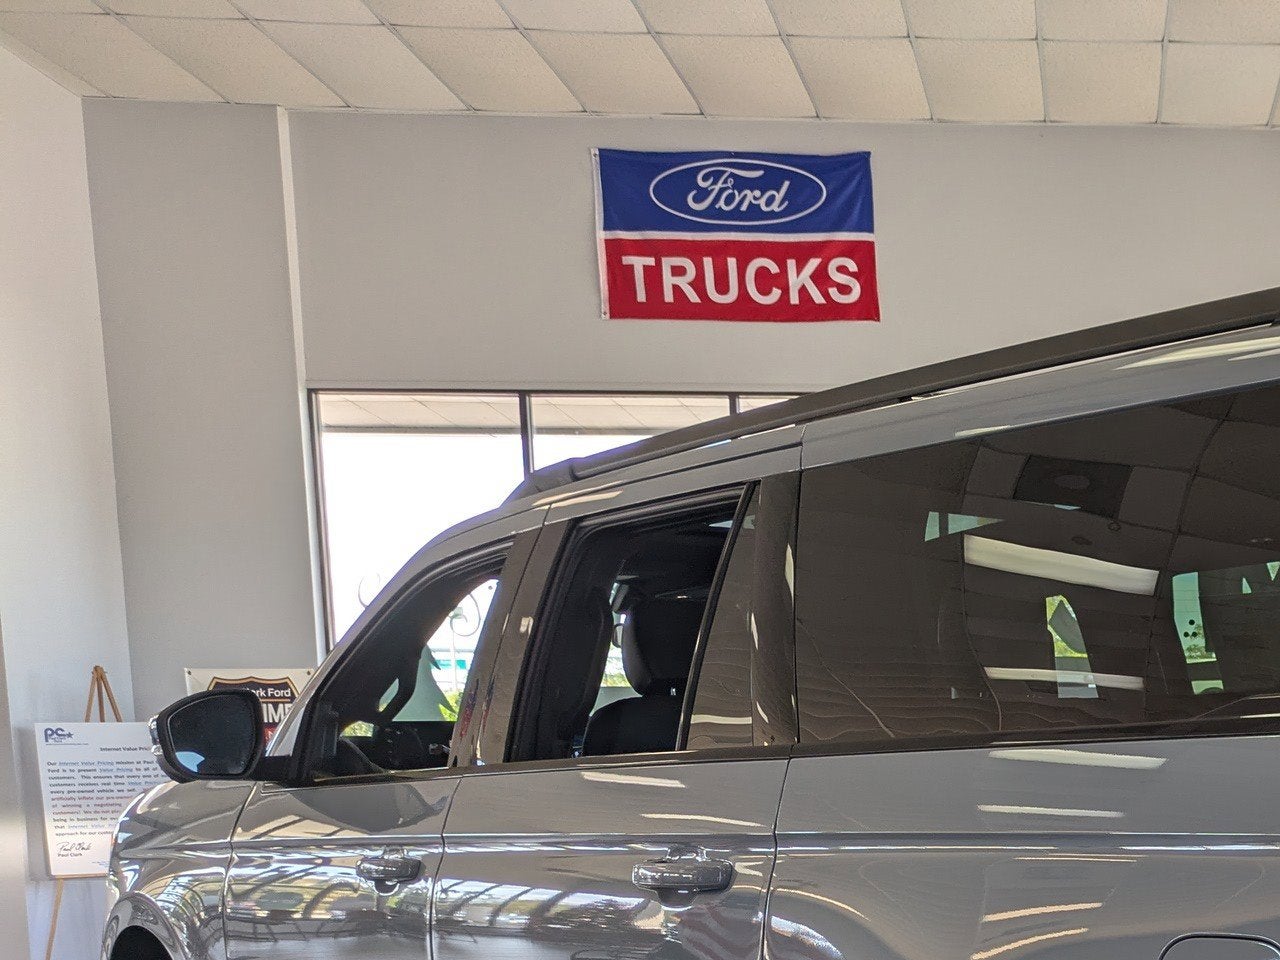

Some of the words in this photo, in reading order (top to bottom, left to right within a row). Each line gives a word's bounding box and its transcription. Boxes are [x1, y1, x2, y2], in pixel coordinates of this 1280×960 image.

[686, 167, 791, 212] Ford
[621, 255, 862, 305] TRUCKS
[267, 688, 291, 697] Ford
